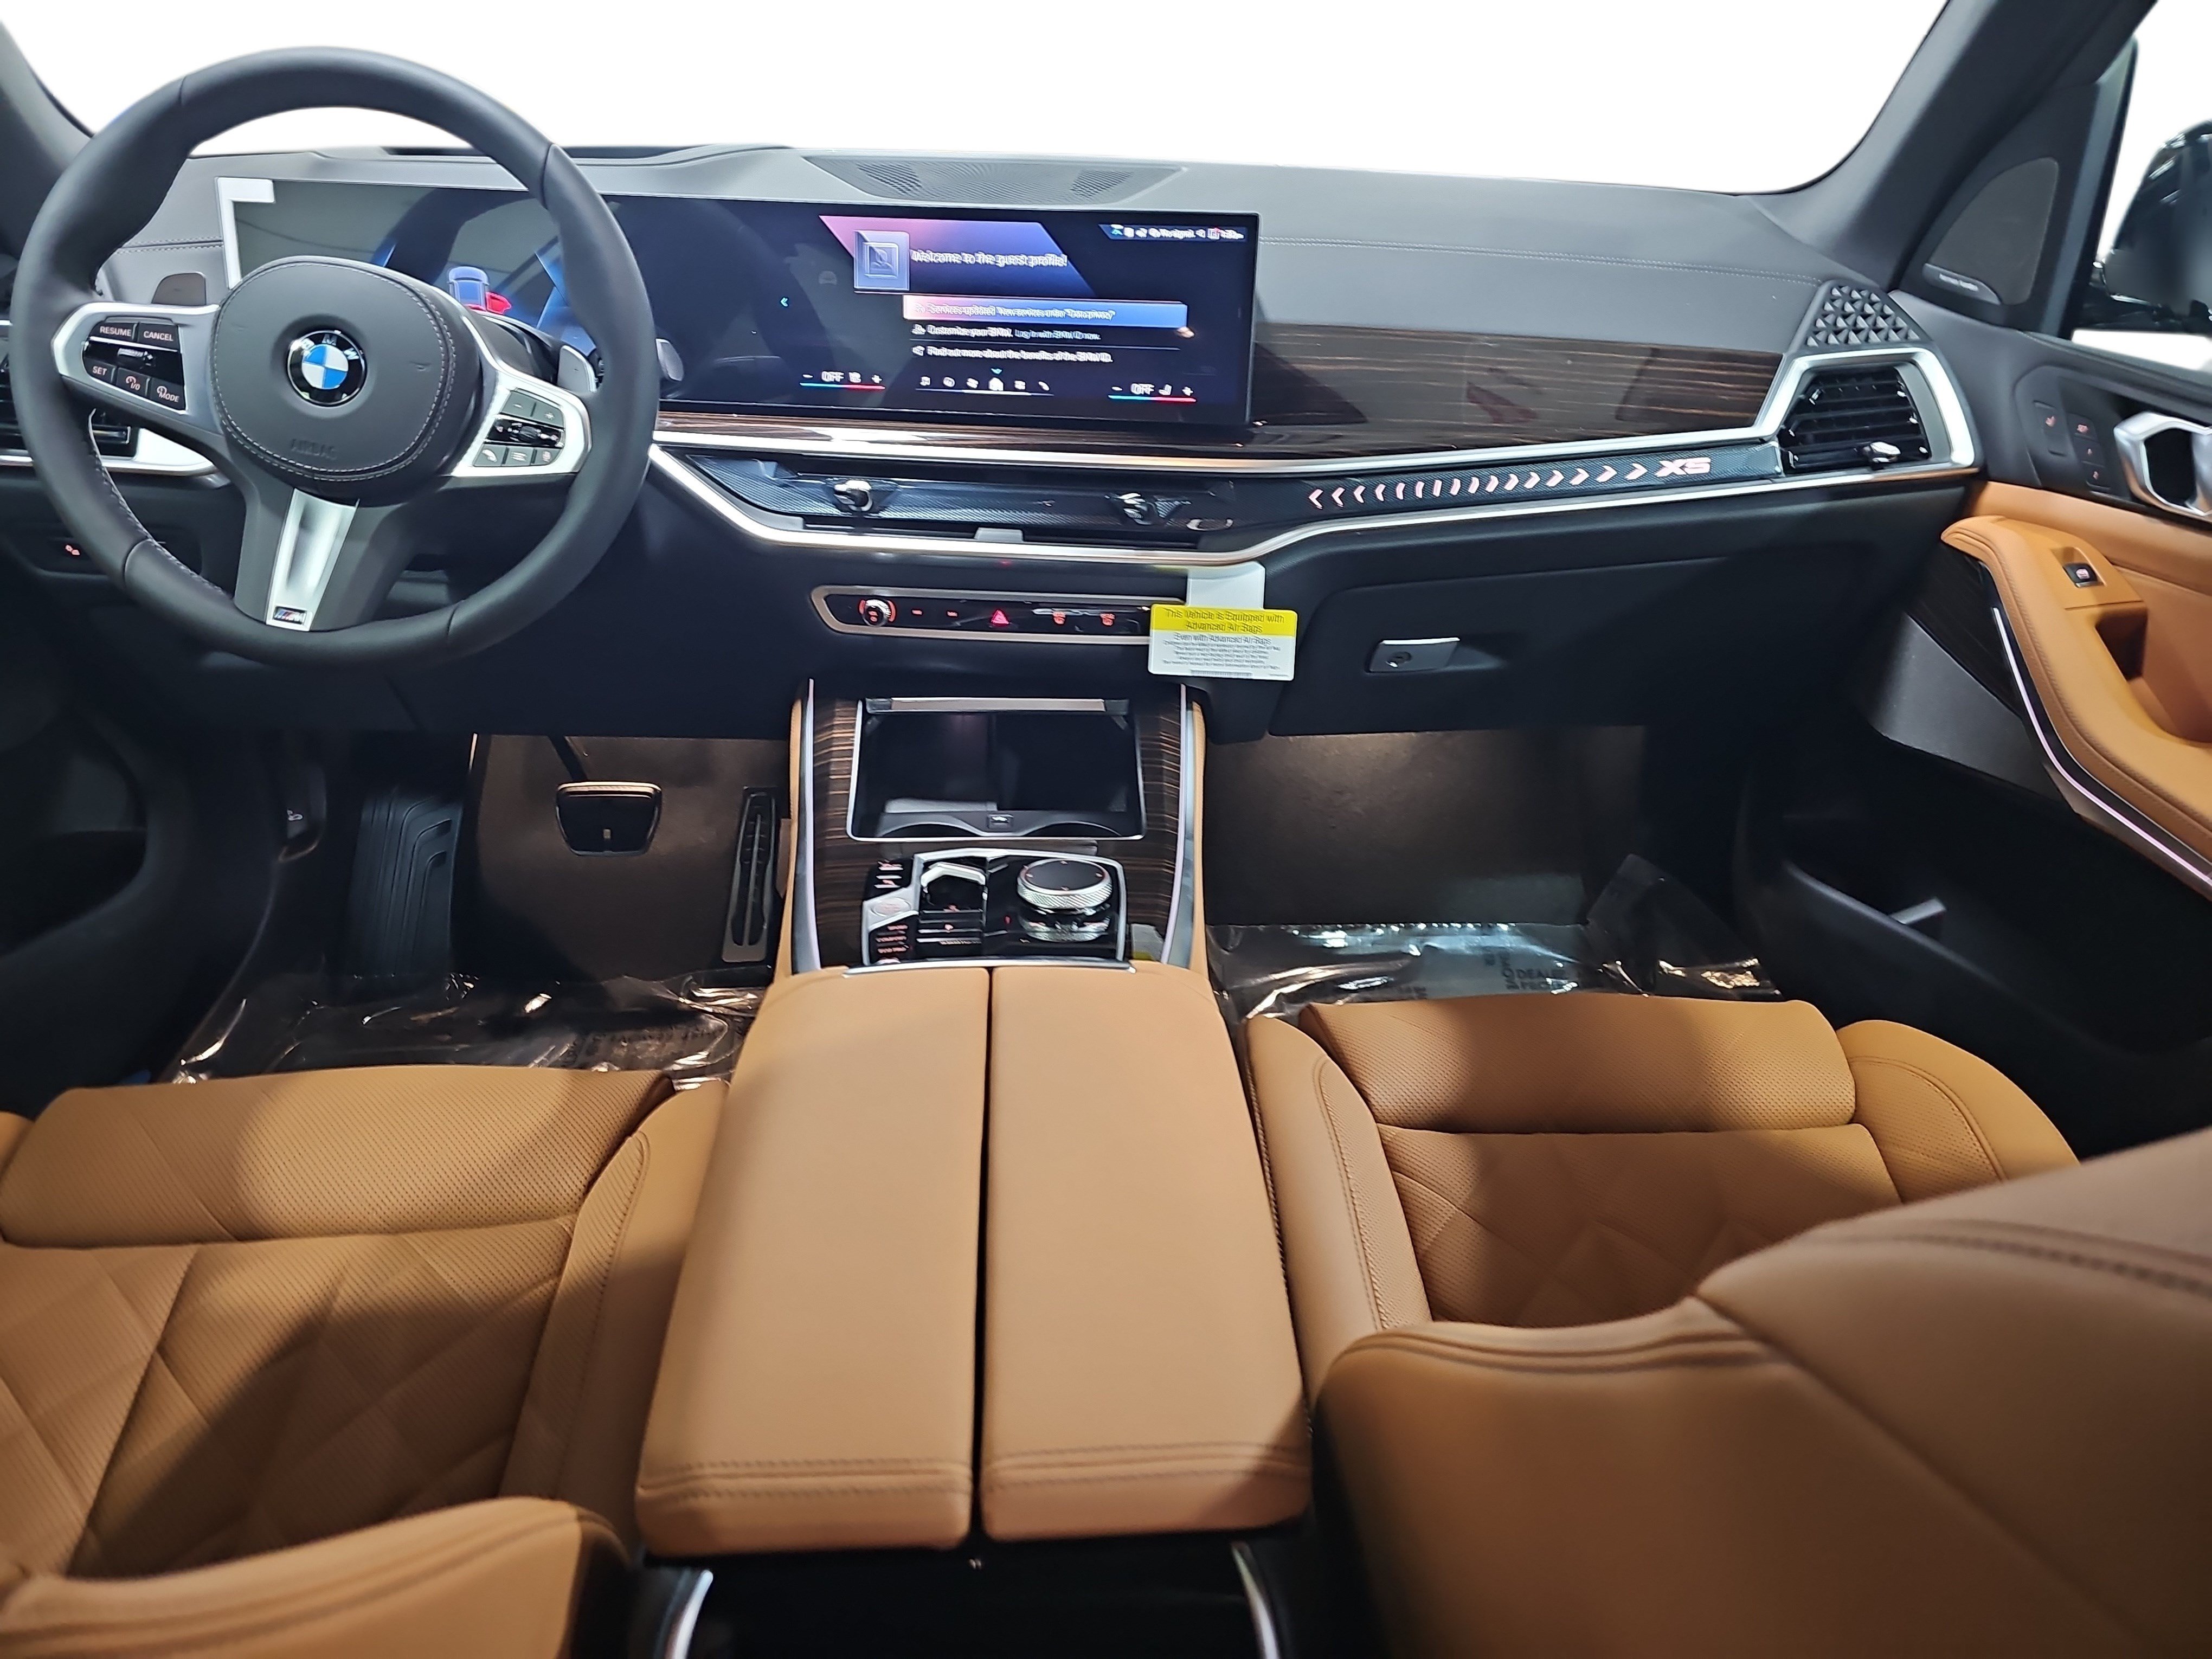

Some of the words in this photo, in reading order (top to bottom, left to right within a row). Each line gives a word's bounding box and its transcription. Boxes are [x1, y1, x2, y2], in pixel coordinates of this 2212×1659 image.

[909, 249, 962, 263] Welcome
[961, 252, 975, 265] to
[975, 251, 995, 265] the
[995, 253, 1028, 267] guest
[1028, 253, 1068, 268] profile!
[926, 303, 962, 315] Services
[100, 326, 132, 337] RESUME
[143, 330, 173, 342] CANCEL
[299, 333, 359, 361] BMW
[927, 345, 949, 356] Find
[93, 365, 107, 376] SET
[821, 371, 844, 382] OFF
[1131, 383, 1155, 395] OFF
[158, 390, 179, 402] MODE
[1163, 607, 1183, 618] This
[1186, 609, 1214, 620] Vehicle
[1216, 611, 1225, 621] is
[1225, 610, 1264, 624] Equipped
[1266, 613, 1285, 623] with
[1185, 620, 1226, 632] Advanced
[1227, 621, 1241, 632] Air
[1240, 622, 1263, 634] Bags
[1173, 632, 1192, 641] Even
[1193, 633, 1208, 642] with
[1207, 634, 1243, 644] Advanced
[1242, 635, 1253, 644] Air
[1251, 636, 1272, 647] Bags
